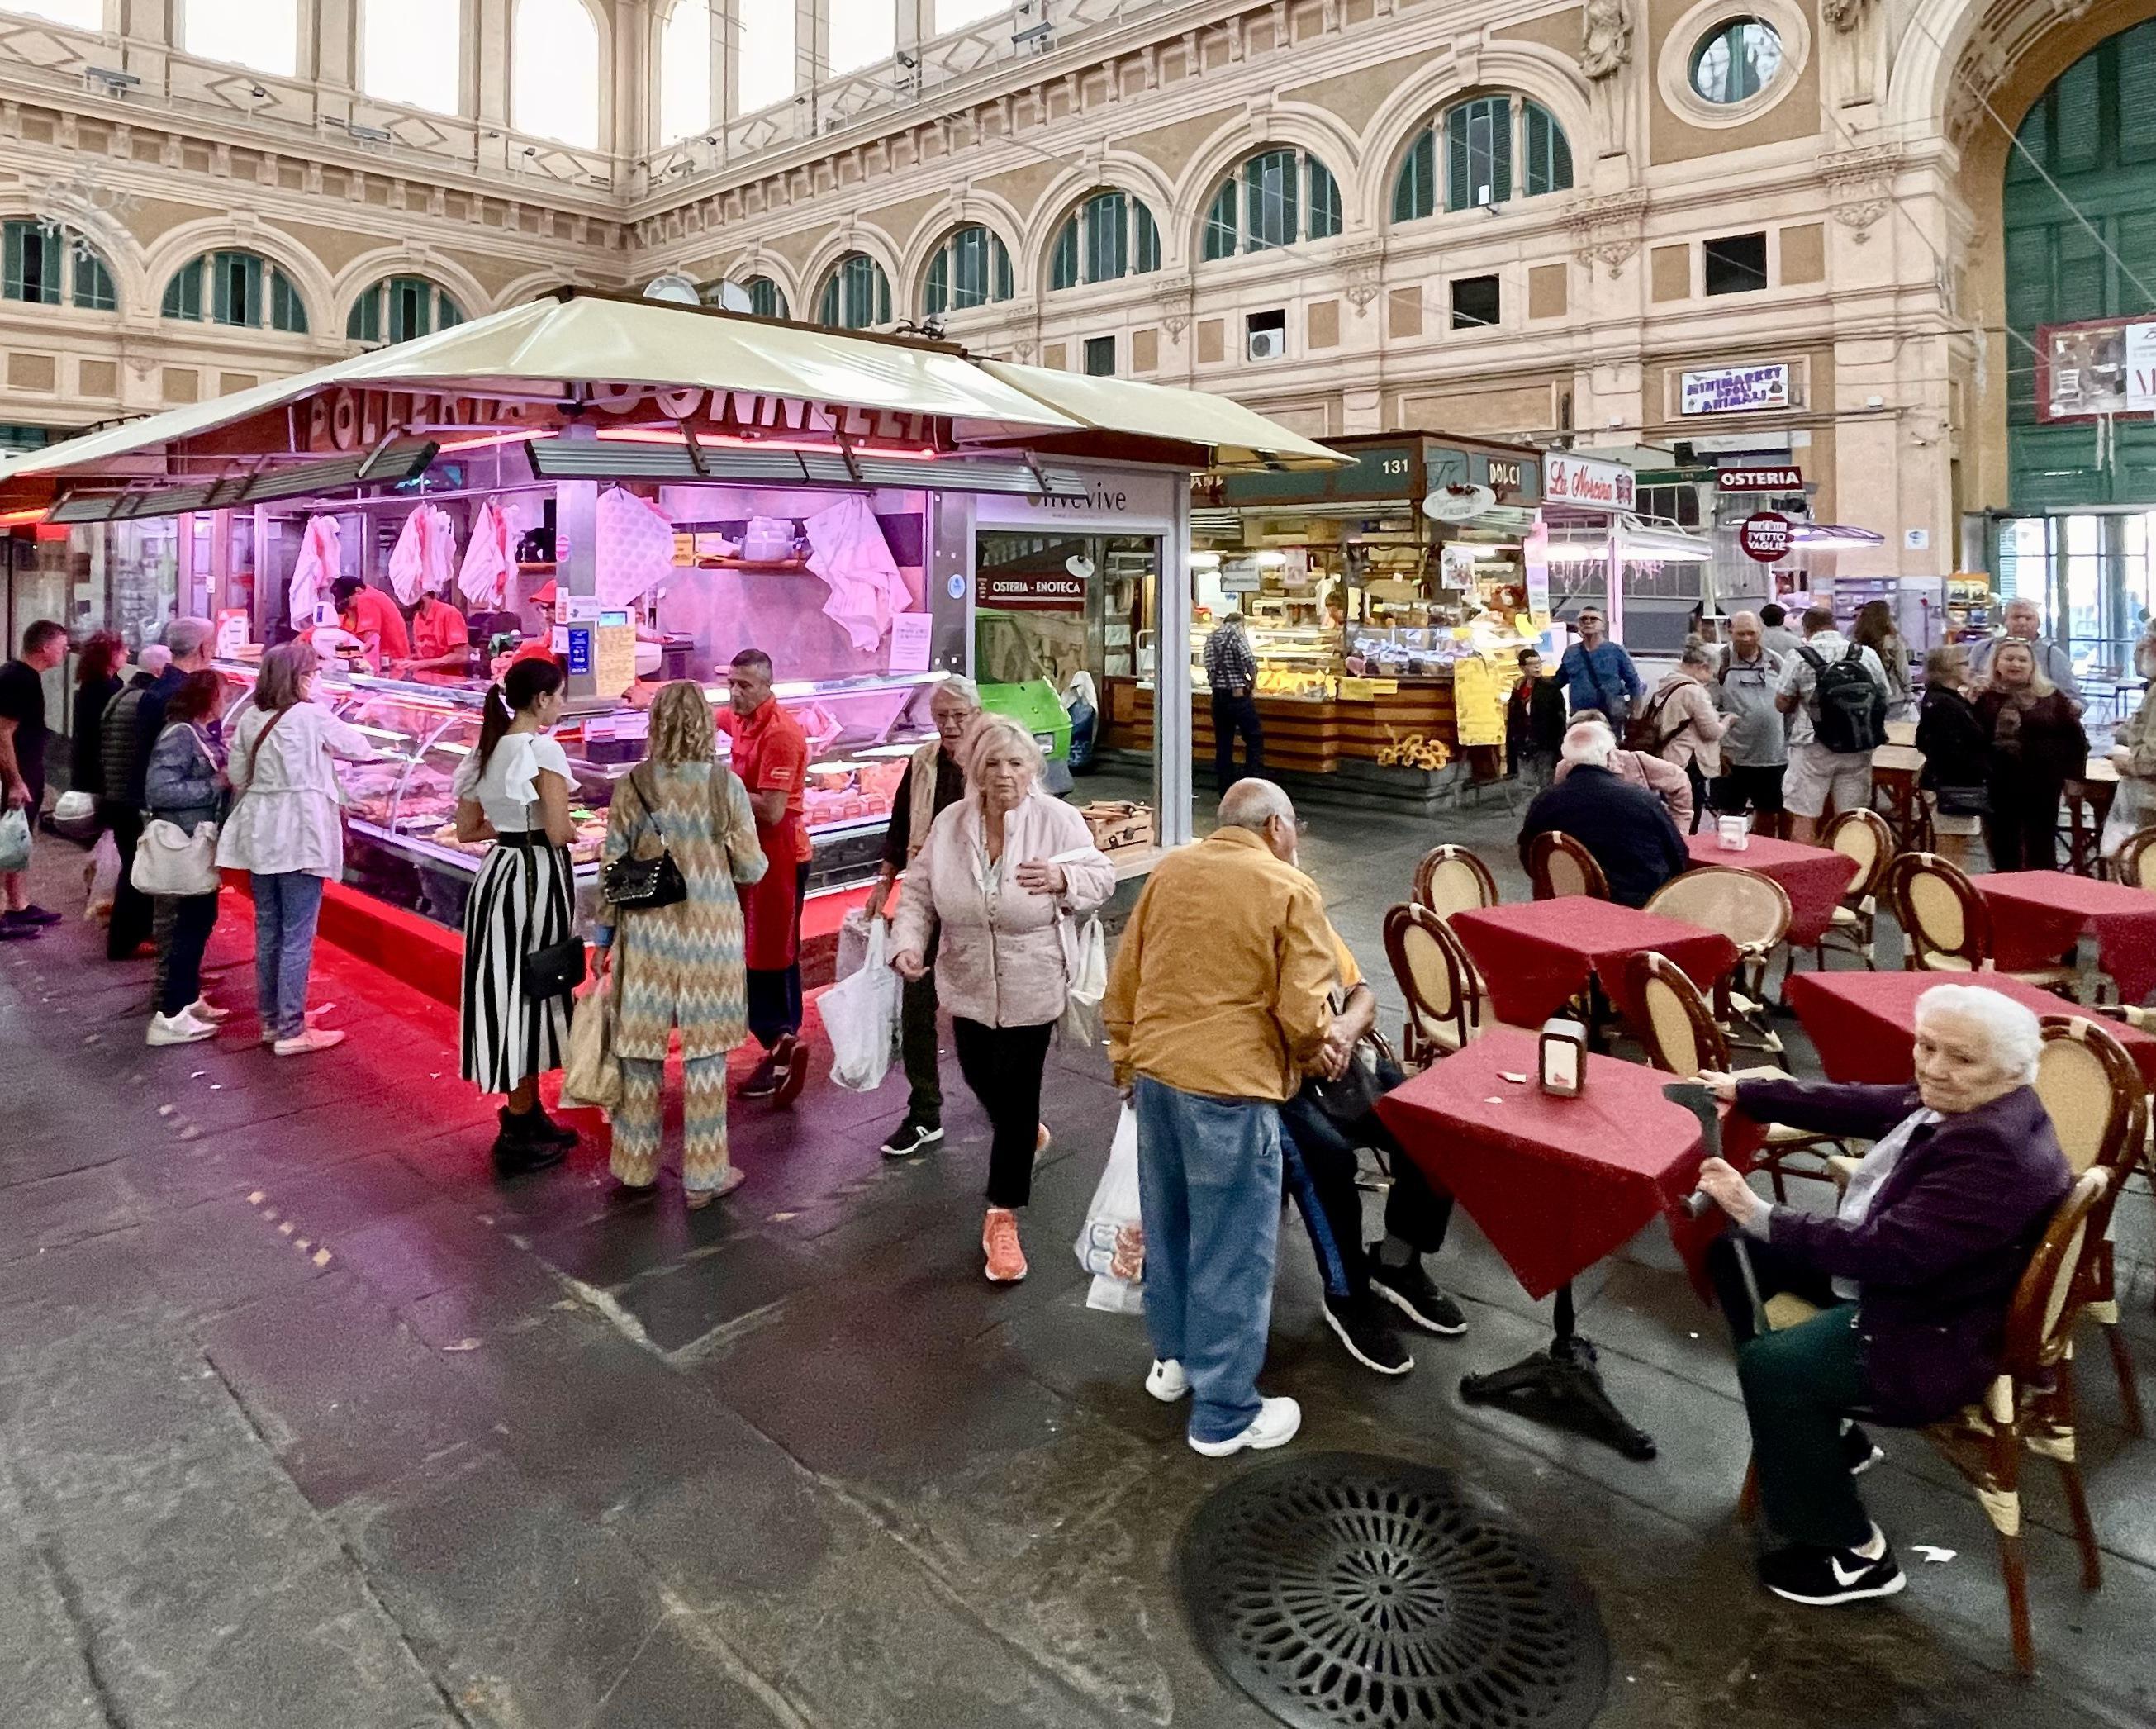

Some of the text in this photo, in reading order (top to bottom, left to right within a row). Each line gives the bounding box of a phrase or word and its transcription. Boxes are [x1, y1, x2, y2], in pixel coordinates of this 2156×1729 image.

[1382, 458, 1408, 474] 131
[1489, 463, 1521, 486] DOLCI
[1721, 471, 1800, 486] OSTERIA
[1748, 541, 1786, 551] VAGLIE
[992, 581, 1028, 593] OSTERIA
[1036, 581, 1081, 593] ENOTECA
